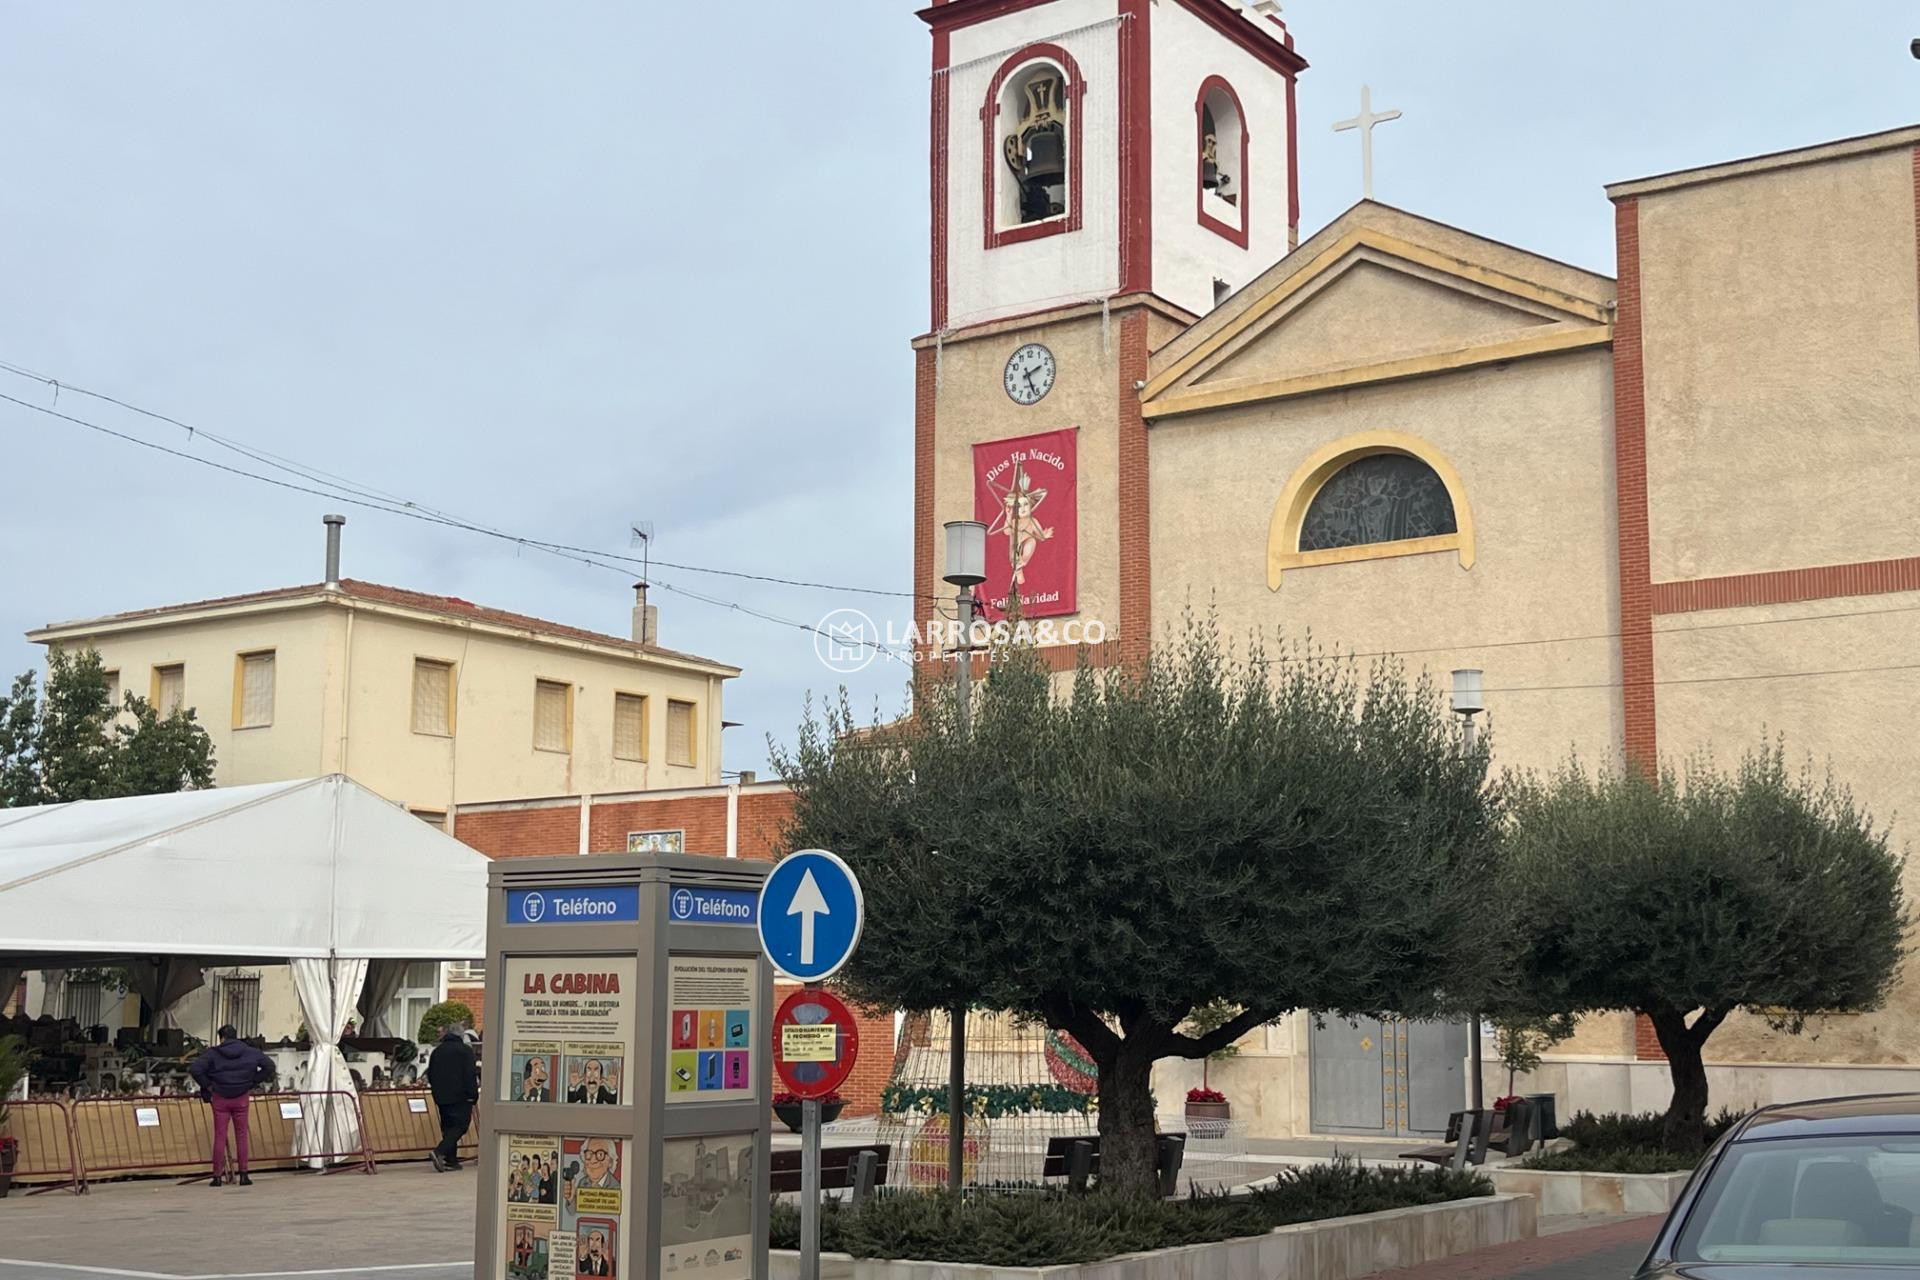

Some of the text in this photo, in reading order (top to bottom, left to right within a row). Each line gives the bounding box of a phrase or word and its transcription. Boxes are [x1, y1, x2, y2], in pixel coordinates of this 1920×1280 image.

[1026, 350, 1034, 358] 12
[1044, 357, 1048, 365] 2
[1012, 363, 1019, 371] 10
[1046, 368, 1051, 376] 3
[1009, 373, 1014, 382] 9
[1012, 384, 1016, 392] 8
[1027, 391, 1032, 399] 6
[986, 448, 1065, 482] Dios Ha Nacido
[990, 598, 1010, 610] Feli
[553, 898, 617, 916] Teléfono
[694, 897, 750, 918] Teléfono
[524, 974, 620, 994] LA CABINA
